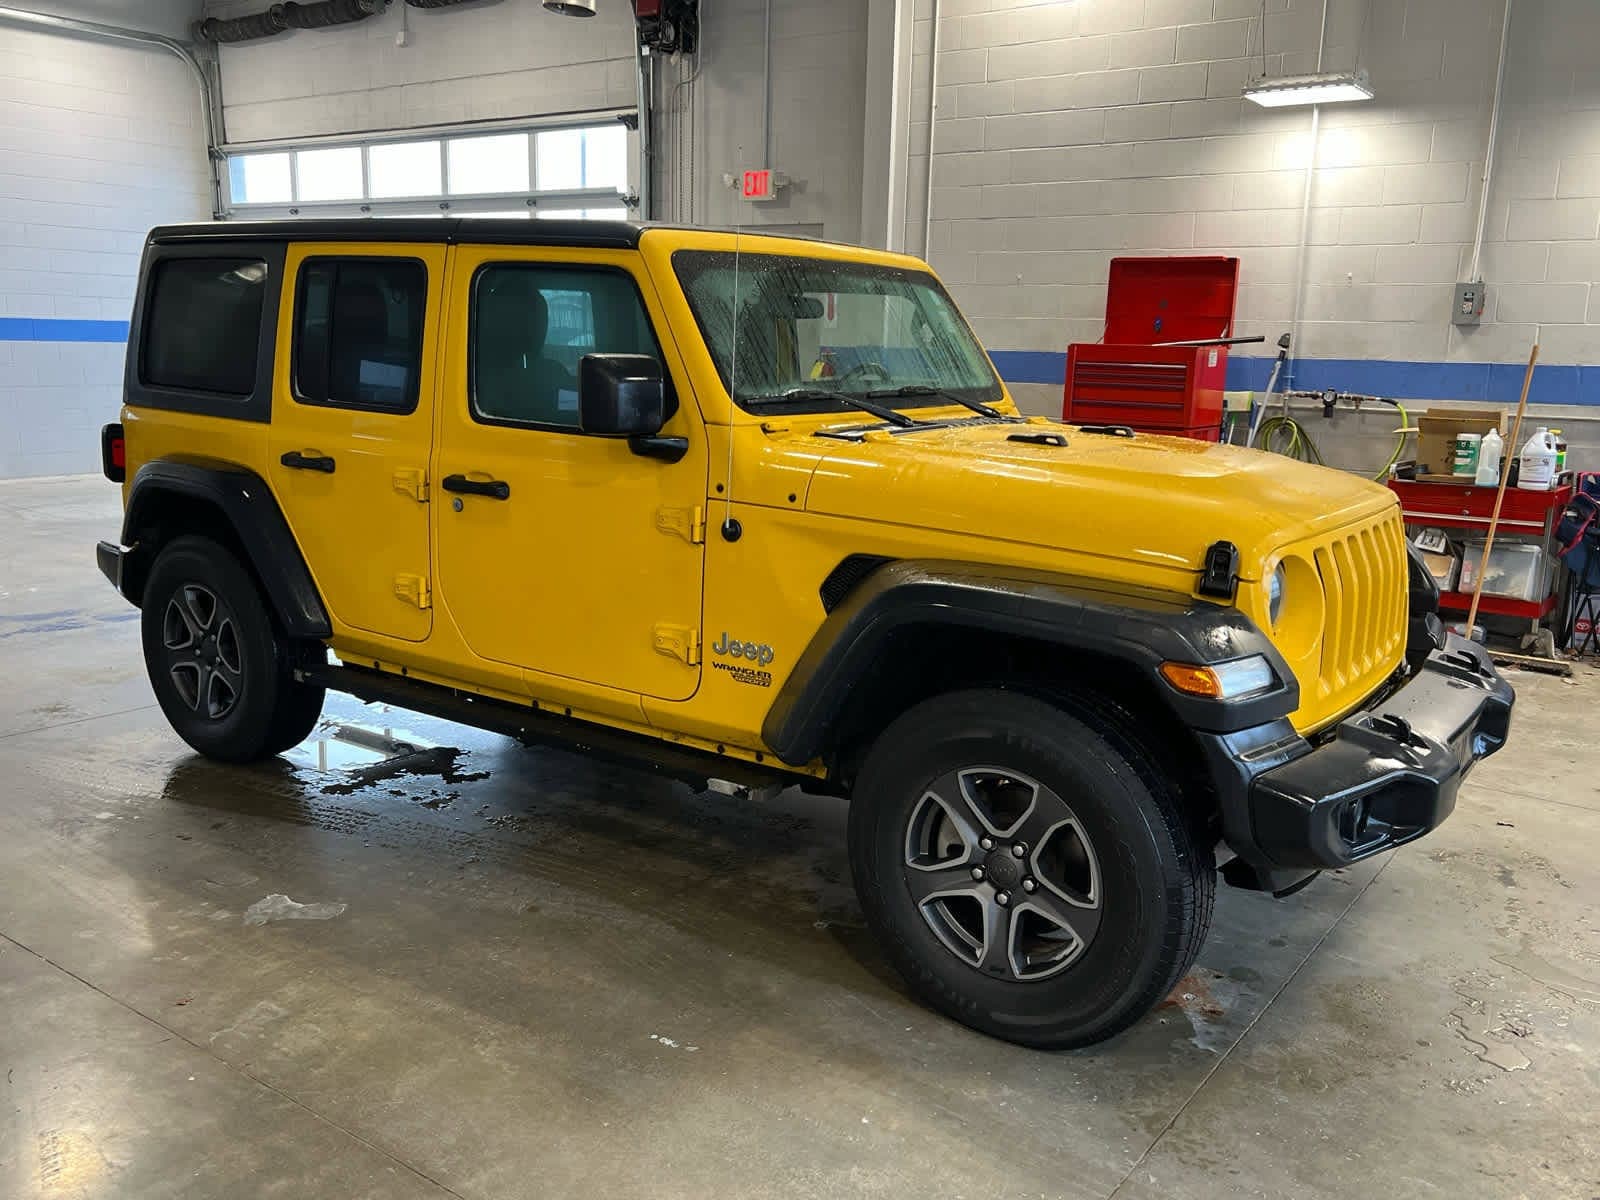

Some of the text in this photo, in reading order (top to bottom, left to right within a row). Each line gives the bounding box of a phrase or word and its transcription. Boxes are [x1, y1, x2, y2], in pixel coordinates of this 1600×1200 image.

[743, 171, 769, 196] EXIT
[712, 631, 774, 667] Jeep
[712, 661, 772, 679] WRANGLER
